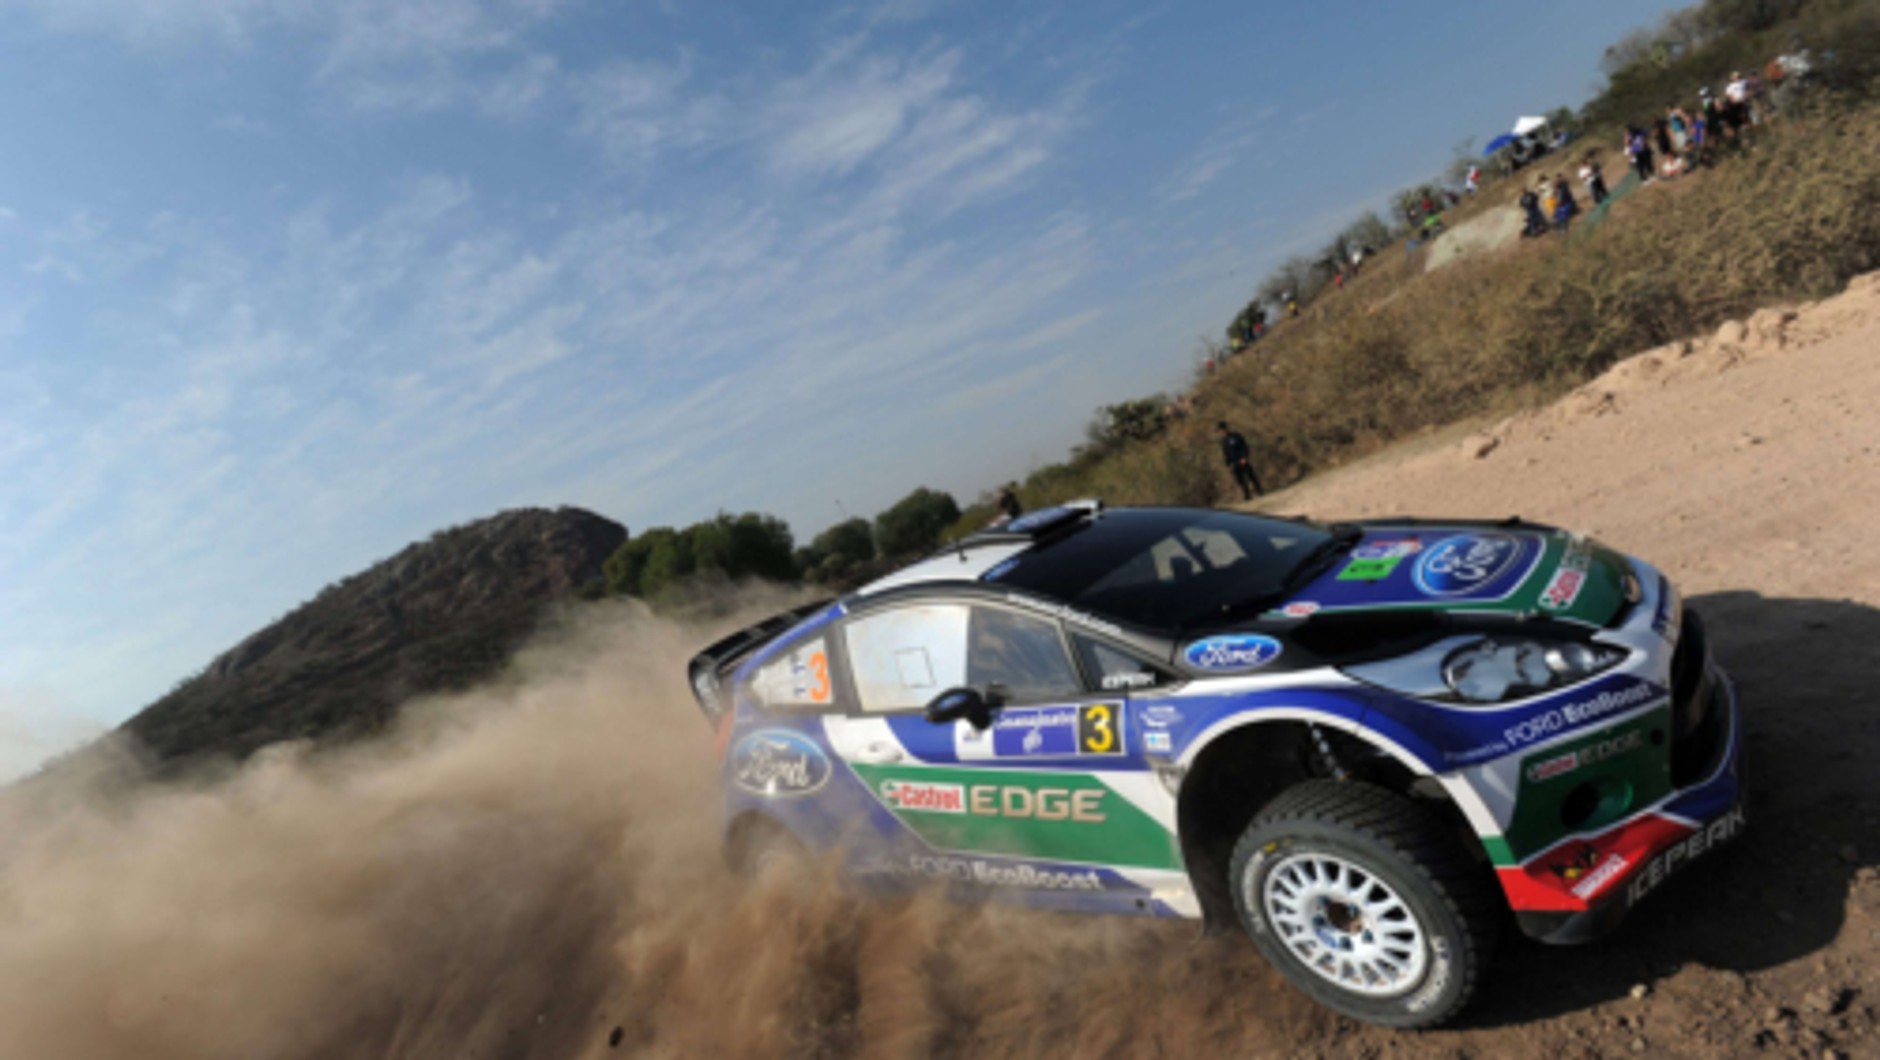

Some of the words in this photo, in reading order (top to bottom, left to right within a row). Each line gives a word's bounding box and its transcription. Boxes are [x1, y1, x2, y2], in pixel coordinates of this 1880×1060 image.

[1428, 535, 1508, 582] Ford
[1199, 639, 1263, 667] Ford
[808, 651, 831, 704] 3
[1086, 704, 1114, 753] 3
[1504, 709, 1562, 746] FORD
[1562, 683, 1652, 724] EcoBoost
[738, 739, 811, 788] Ford
[898, 783, 962, 810] Castrol
[969, 785, 1107, 822] EDGE
[971, 860, 1105, 890] EcoBoost
